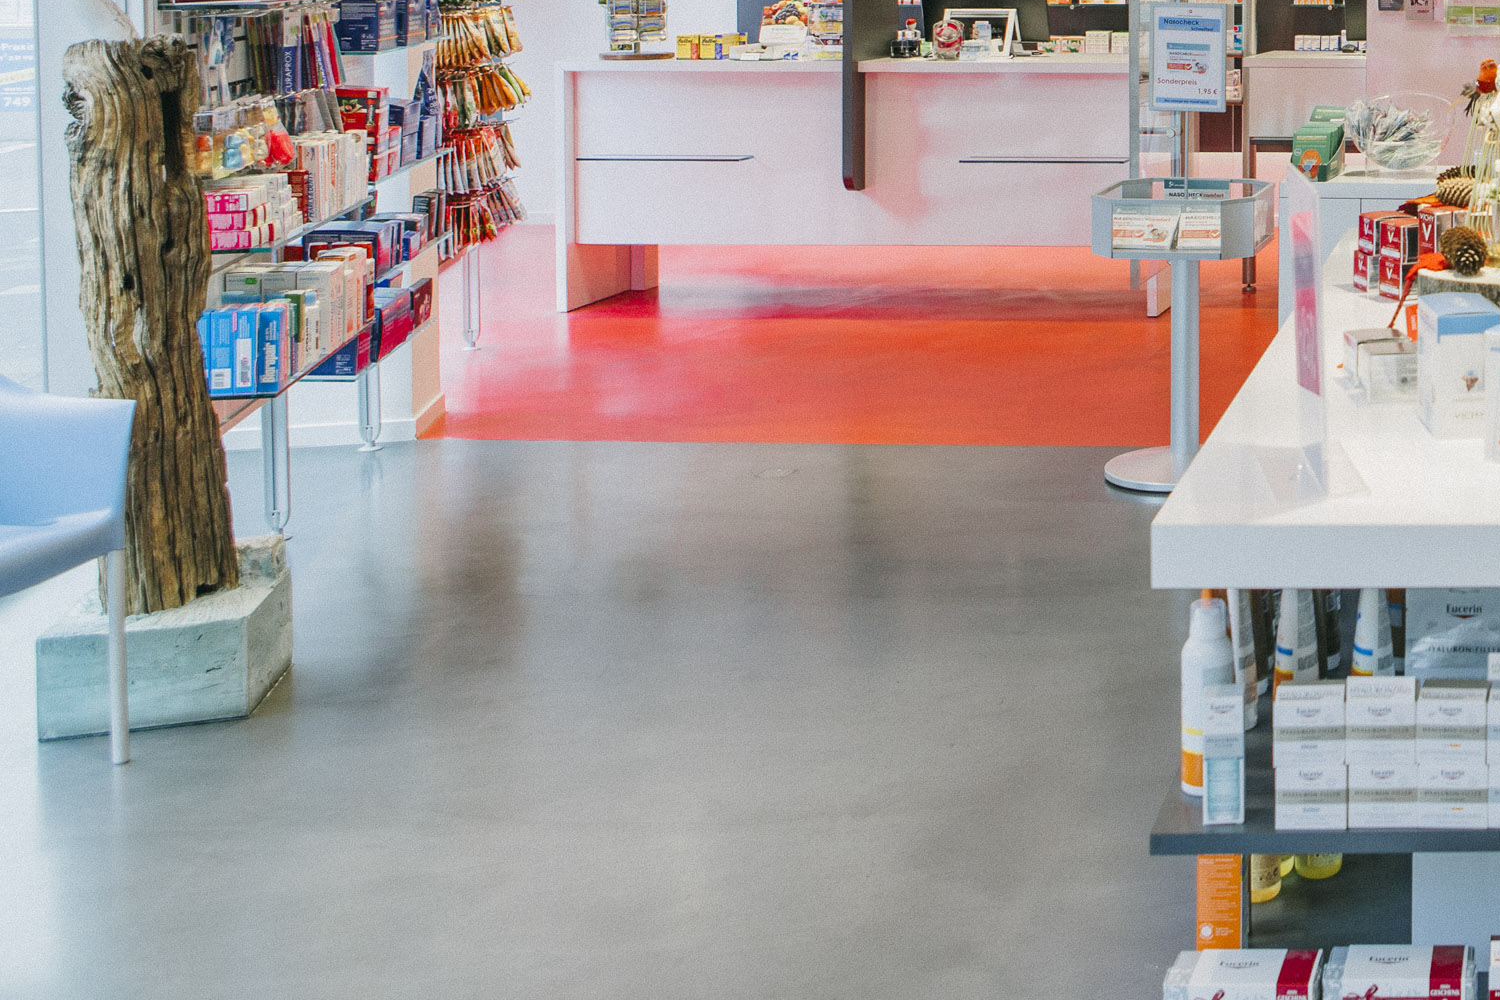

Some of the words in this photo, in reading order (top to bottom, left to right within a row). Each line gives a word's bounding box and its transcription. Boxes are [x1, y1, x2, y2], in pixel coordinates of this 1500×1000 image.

[285, 50, 294, 93] CURAPROX
[1157, 78, 1198, 86] Sonderpreis
[260, 342, 278, 383] Biorepair
[1446, 604, 1483, 614] Eucerin
